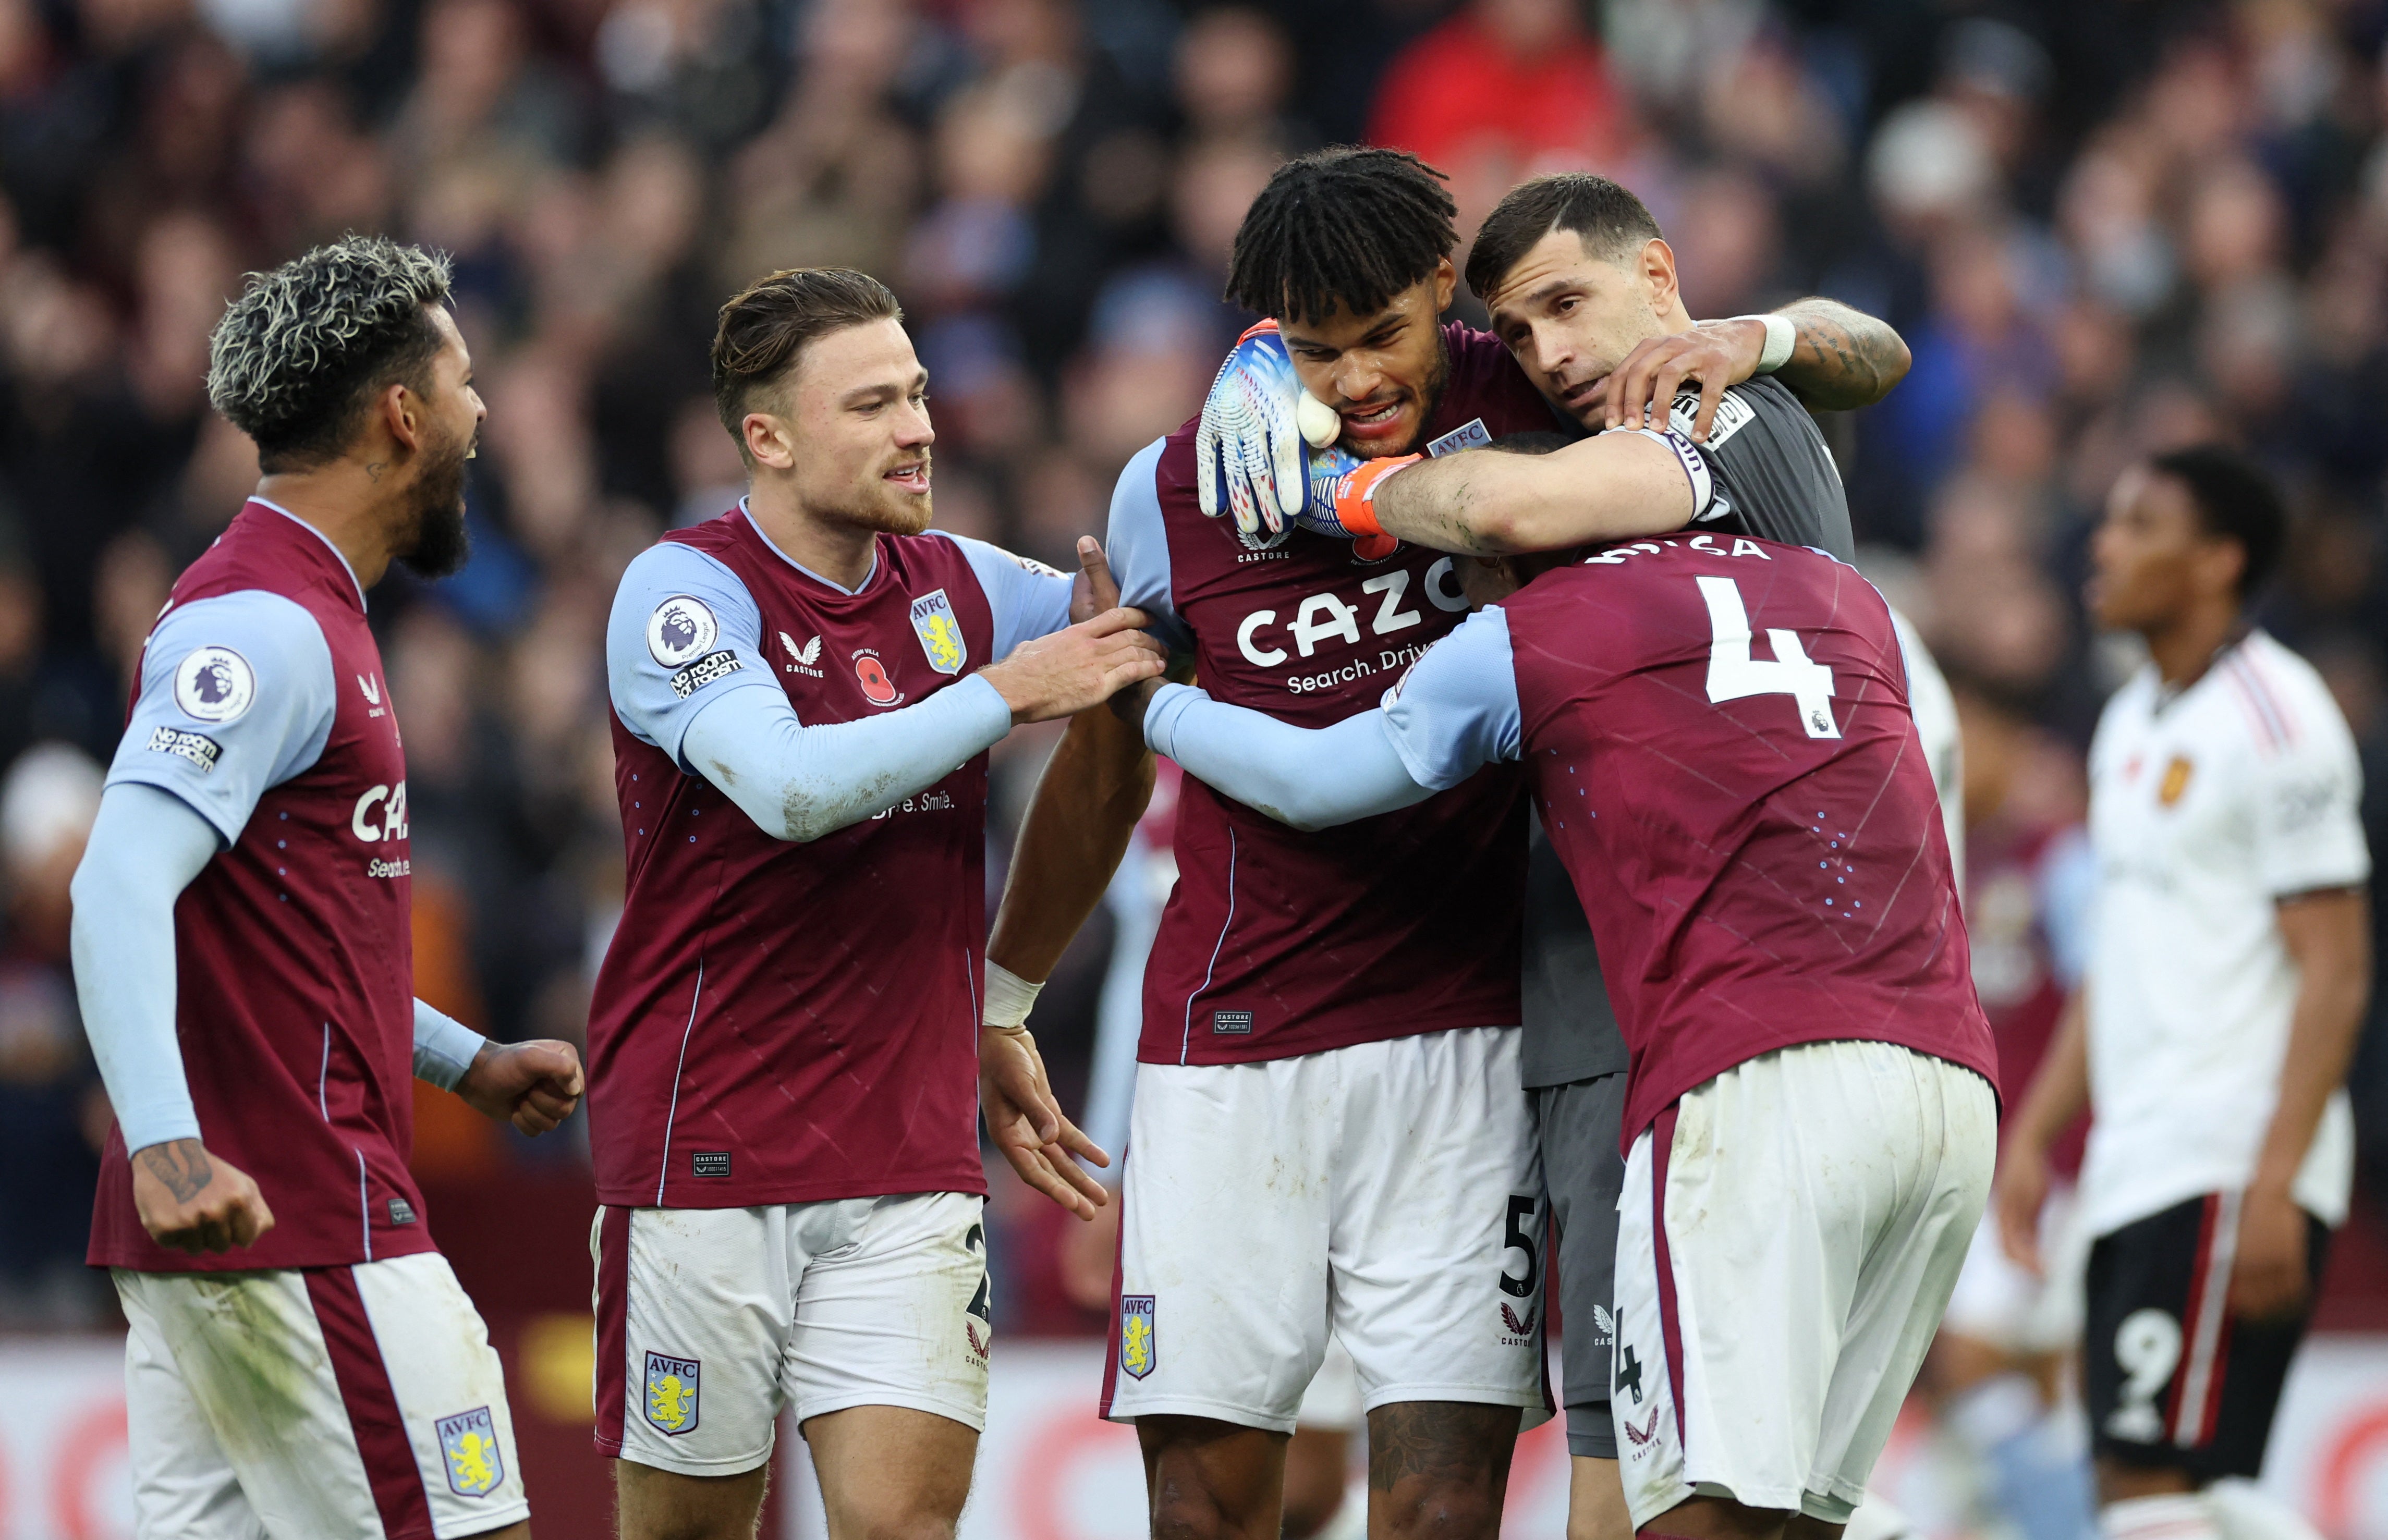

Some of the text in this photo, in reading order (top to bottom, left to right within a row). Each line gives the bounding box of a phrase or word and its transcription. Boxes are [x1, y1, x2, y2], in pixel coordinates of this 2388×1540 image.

[1437, 425, 1483, 455] AVFC
[1238, 552, 1289, 563] CASTORE
[913, 595, 945, 620] AVFC
[1237, 556, 1472, 667] CAZO
[682, 622, 710, 659] Premier League
[851, 648, 879, 661] ASTON VILLA
[669, 651, 731, 693] No room
[786, 664, 824, 678] CASTORE
[1287, 659, 1377, 694] Search.
[1379, 642, 1430, 670] Driv
[1695, 575, 1843, 740] 4
[677, 659, 744, 700] for racism
[153, 727, 217, 759] No room
[169, 744, 214, 775] racism
[921, 790, 955, 811] Smile.
[1499, 1195, 1537, 1298] 5
[1125, 1300, 1152, 1314] AVFC
[649, 1358, 695, 1378] AVFC
[1615, 1306, 1642, 1405] 4
[2114, 1307, 2183, 1405] 9
[444, 1411, 489, 1437] AVFC
